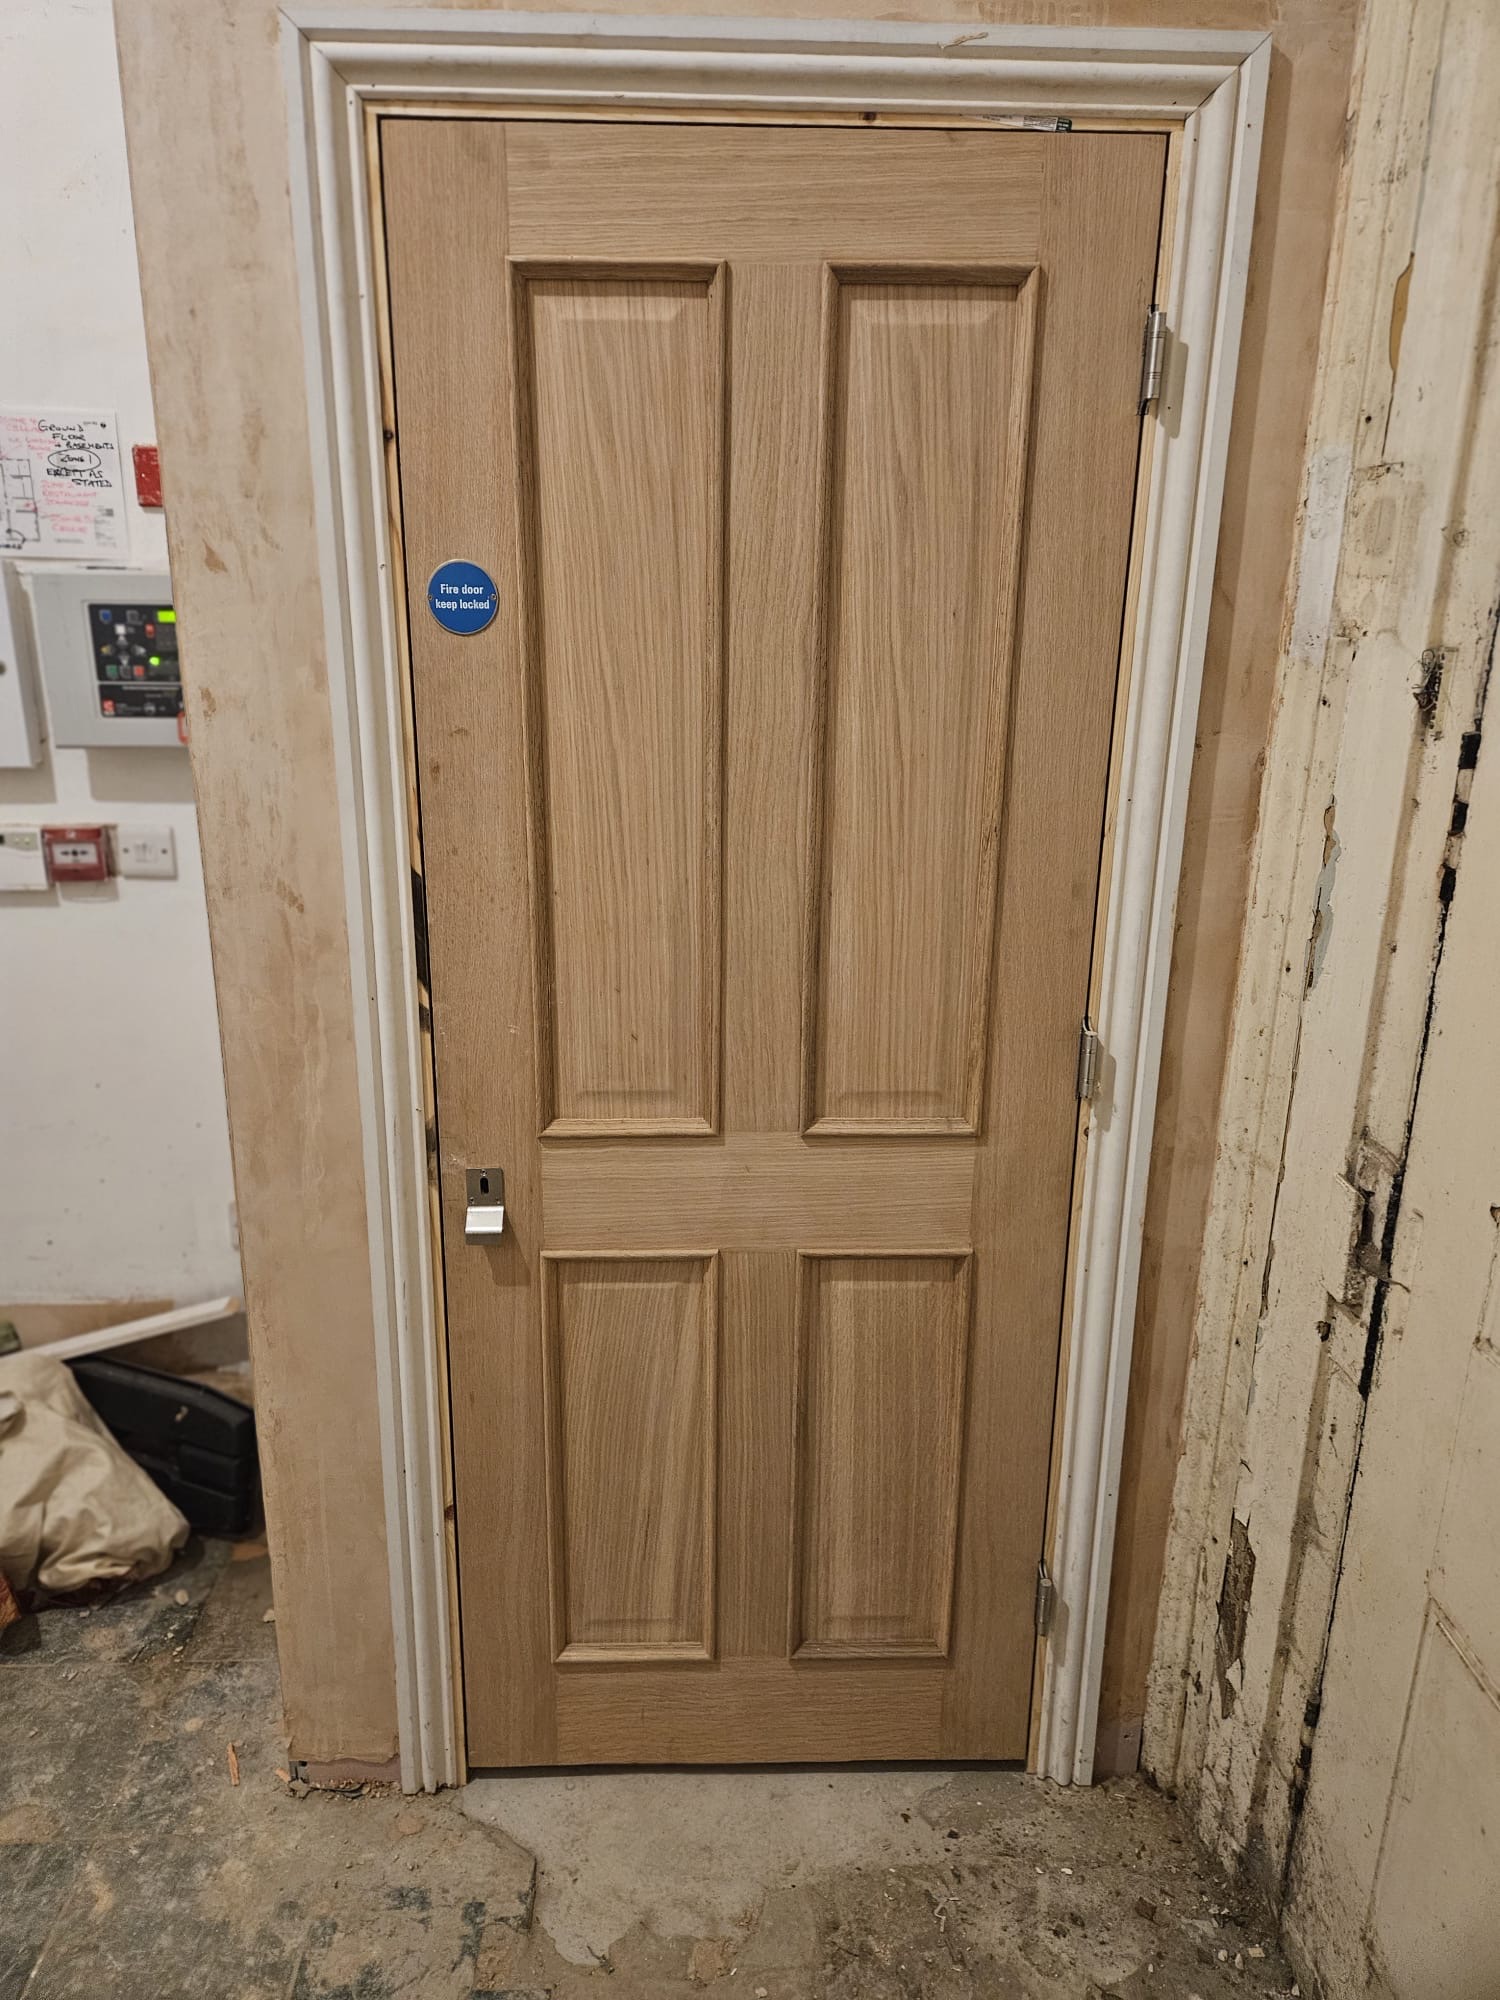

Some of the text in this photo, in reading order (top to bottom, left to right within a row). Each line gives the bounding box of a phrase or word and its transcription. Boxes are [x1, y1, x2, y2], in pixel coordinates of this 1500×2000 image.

[440, 583, 484, 594] Fire door
[435, 598, 490, 611] keep locked
